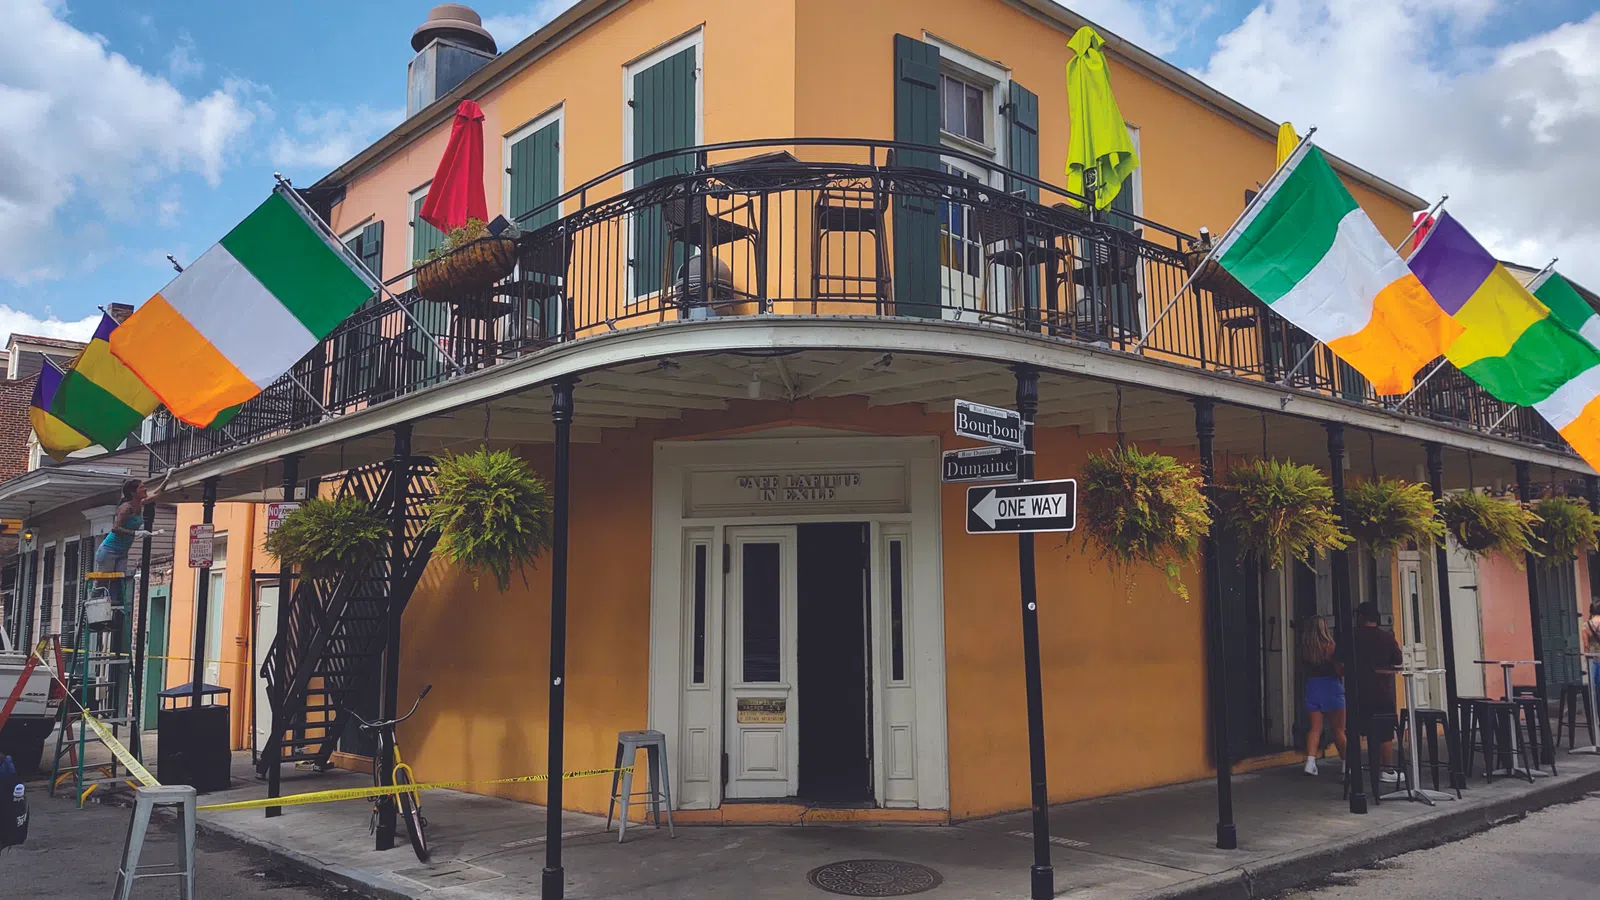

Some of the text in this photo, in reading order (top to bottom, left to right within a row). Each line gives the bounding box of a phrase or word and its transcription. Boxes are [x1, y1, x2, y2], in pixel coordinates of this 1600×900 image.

[958, 412, 1018, 439] Bourbon
[947, 457, 1013, 477] Dumaine
[785, 473, 860, 488] LAFITTE
[760, 487, 835, 501] IN EXILE
[269, 505, 279, 517] NO
[998, 496, 1062, 517] ONE WAY
